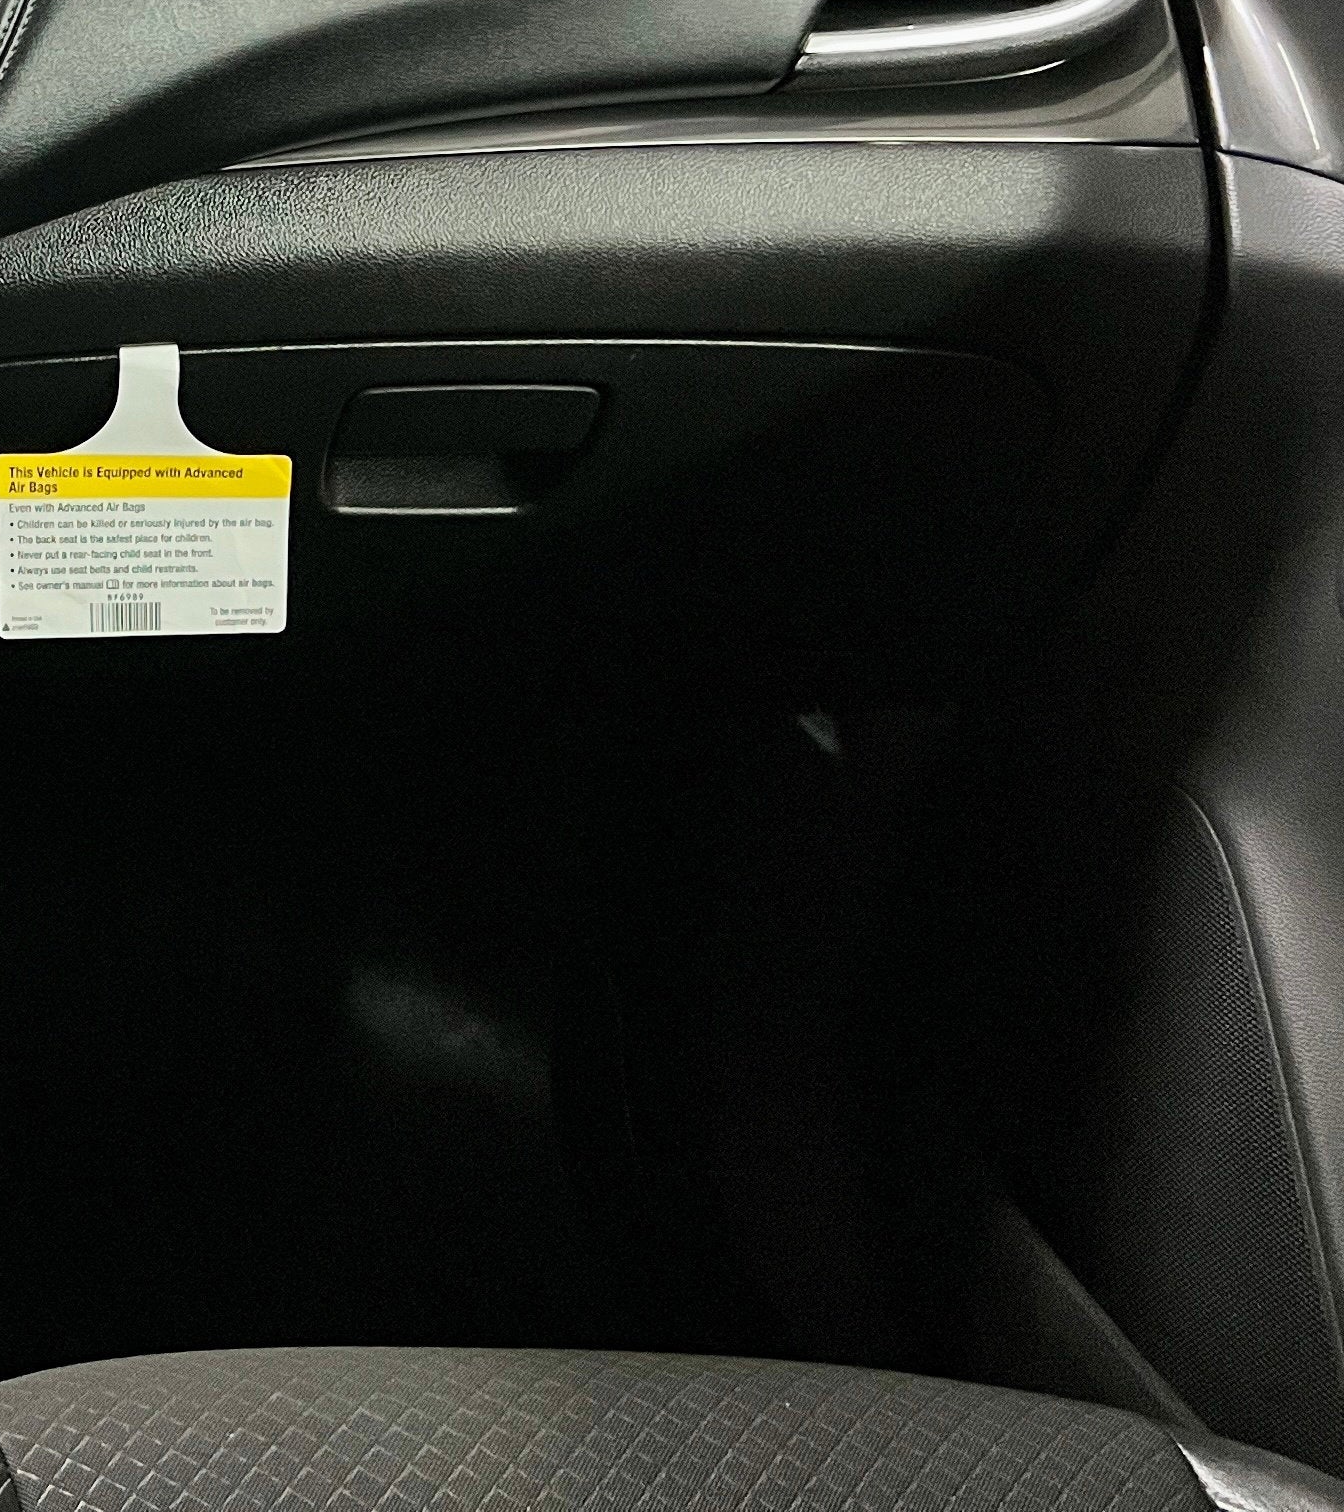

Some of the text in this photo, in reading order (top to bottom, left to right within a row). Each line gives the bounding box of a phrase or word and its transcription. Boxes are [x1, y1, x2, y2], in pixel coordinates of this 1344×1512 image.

[9, 466, 33, 478] This
[37, 466, 80, 478] Vehicle
[96, 466, 151, 480] Equipped
[155, 467, 181, 478] with
[184, 467, 243, 478] Advanced
[8, 481, 58, 495] Air Bags
[8, 502, 146, 513] Even with Advanced Air Bags
[17, 518, 274, 530] Children can be killed or seriously injured by the air bag.
[17, 535, 33, 544] The
[35, 535, 56, 544] back
[59, 535, 78, 544] seat
[80, 534, 88, 543] is
[90, 534, 104, 543] the
[106, 534, 132, 543] safest
[135, 534, 158, 545] place
[160, 534, 172, 543] for
[17, 550, 42, 559] Never
[45, 551, 60, 560] put
[70, 550, 118, 560] rear-facing
[119, 550, 141, 559] child
[143, 549, 161, 558] seat
[164, 549, 172, 558] in
[174, 549, 188, 558] the
[17, 566, 49, 576] Always
[51, 567, 67, 575] use
[69, 566, 87, 575] seat
[89, 565, 111, 574] belts
[113, 565, 130, 574] and
[132, 565, 153, 574] child
[18, 581, 34, 591] See
[36, 581, 70, 590] owner's
[73, 581, 104, 590] manual
[123, 580, 134, 589] for
[136, 581, 158, 589] more
[161, 579, 209, 588] information
[212, 579, 236, 588] about
[238, 579, 249, 588] air
